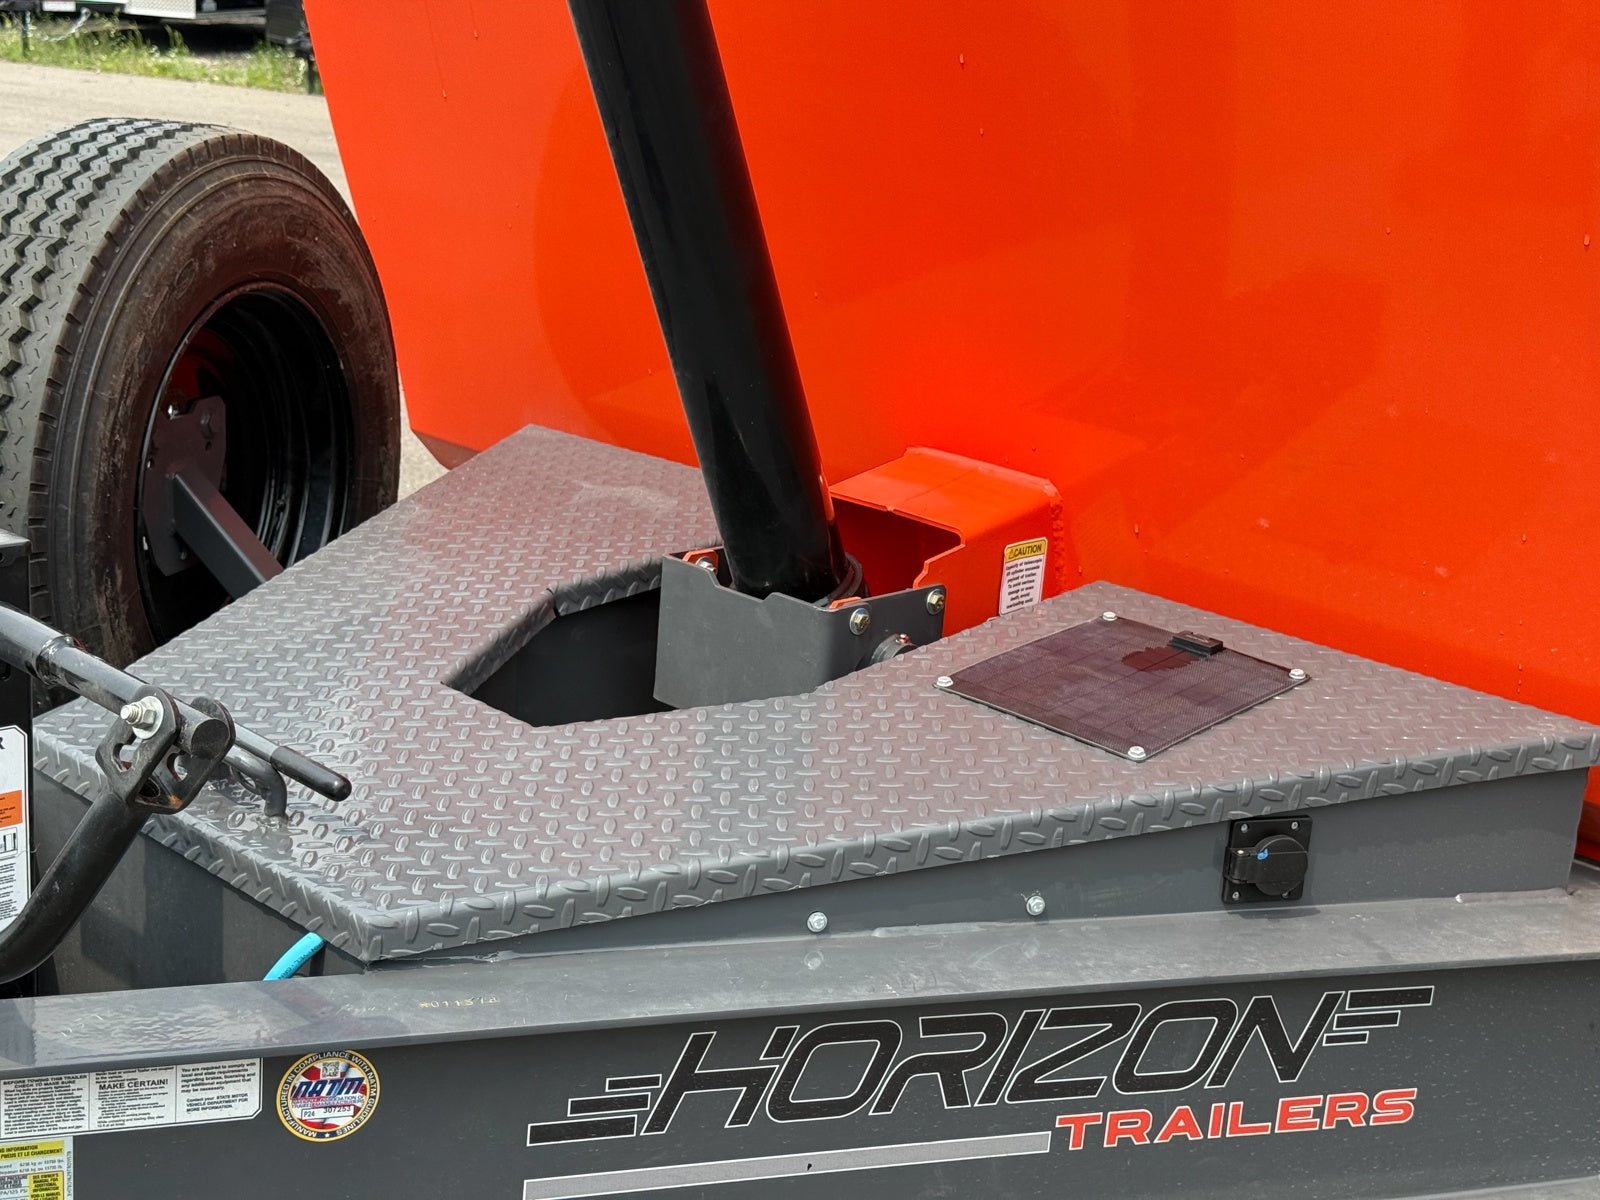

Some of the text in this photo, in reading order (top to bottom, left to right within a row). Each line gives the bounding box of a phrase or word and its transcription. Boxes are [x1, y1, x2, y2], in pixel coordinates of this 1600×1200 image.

[1014, 544, 1042, 557] CAUTION
[128, 1079, 168, 1088] CERTAIN!
[281, 1051, 377, 1138] MANUFACTURED IN COMPLIANCE WITH NATM GUIDELINES
[640, 990, 1345, 1136] HORIZON
[1055, 1087, 1418, 1150] TRAILERS
